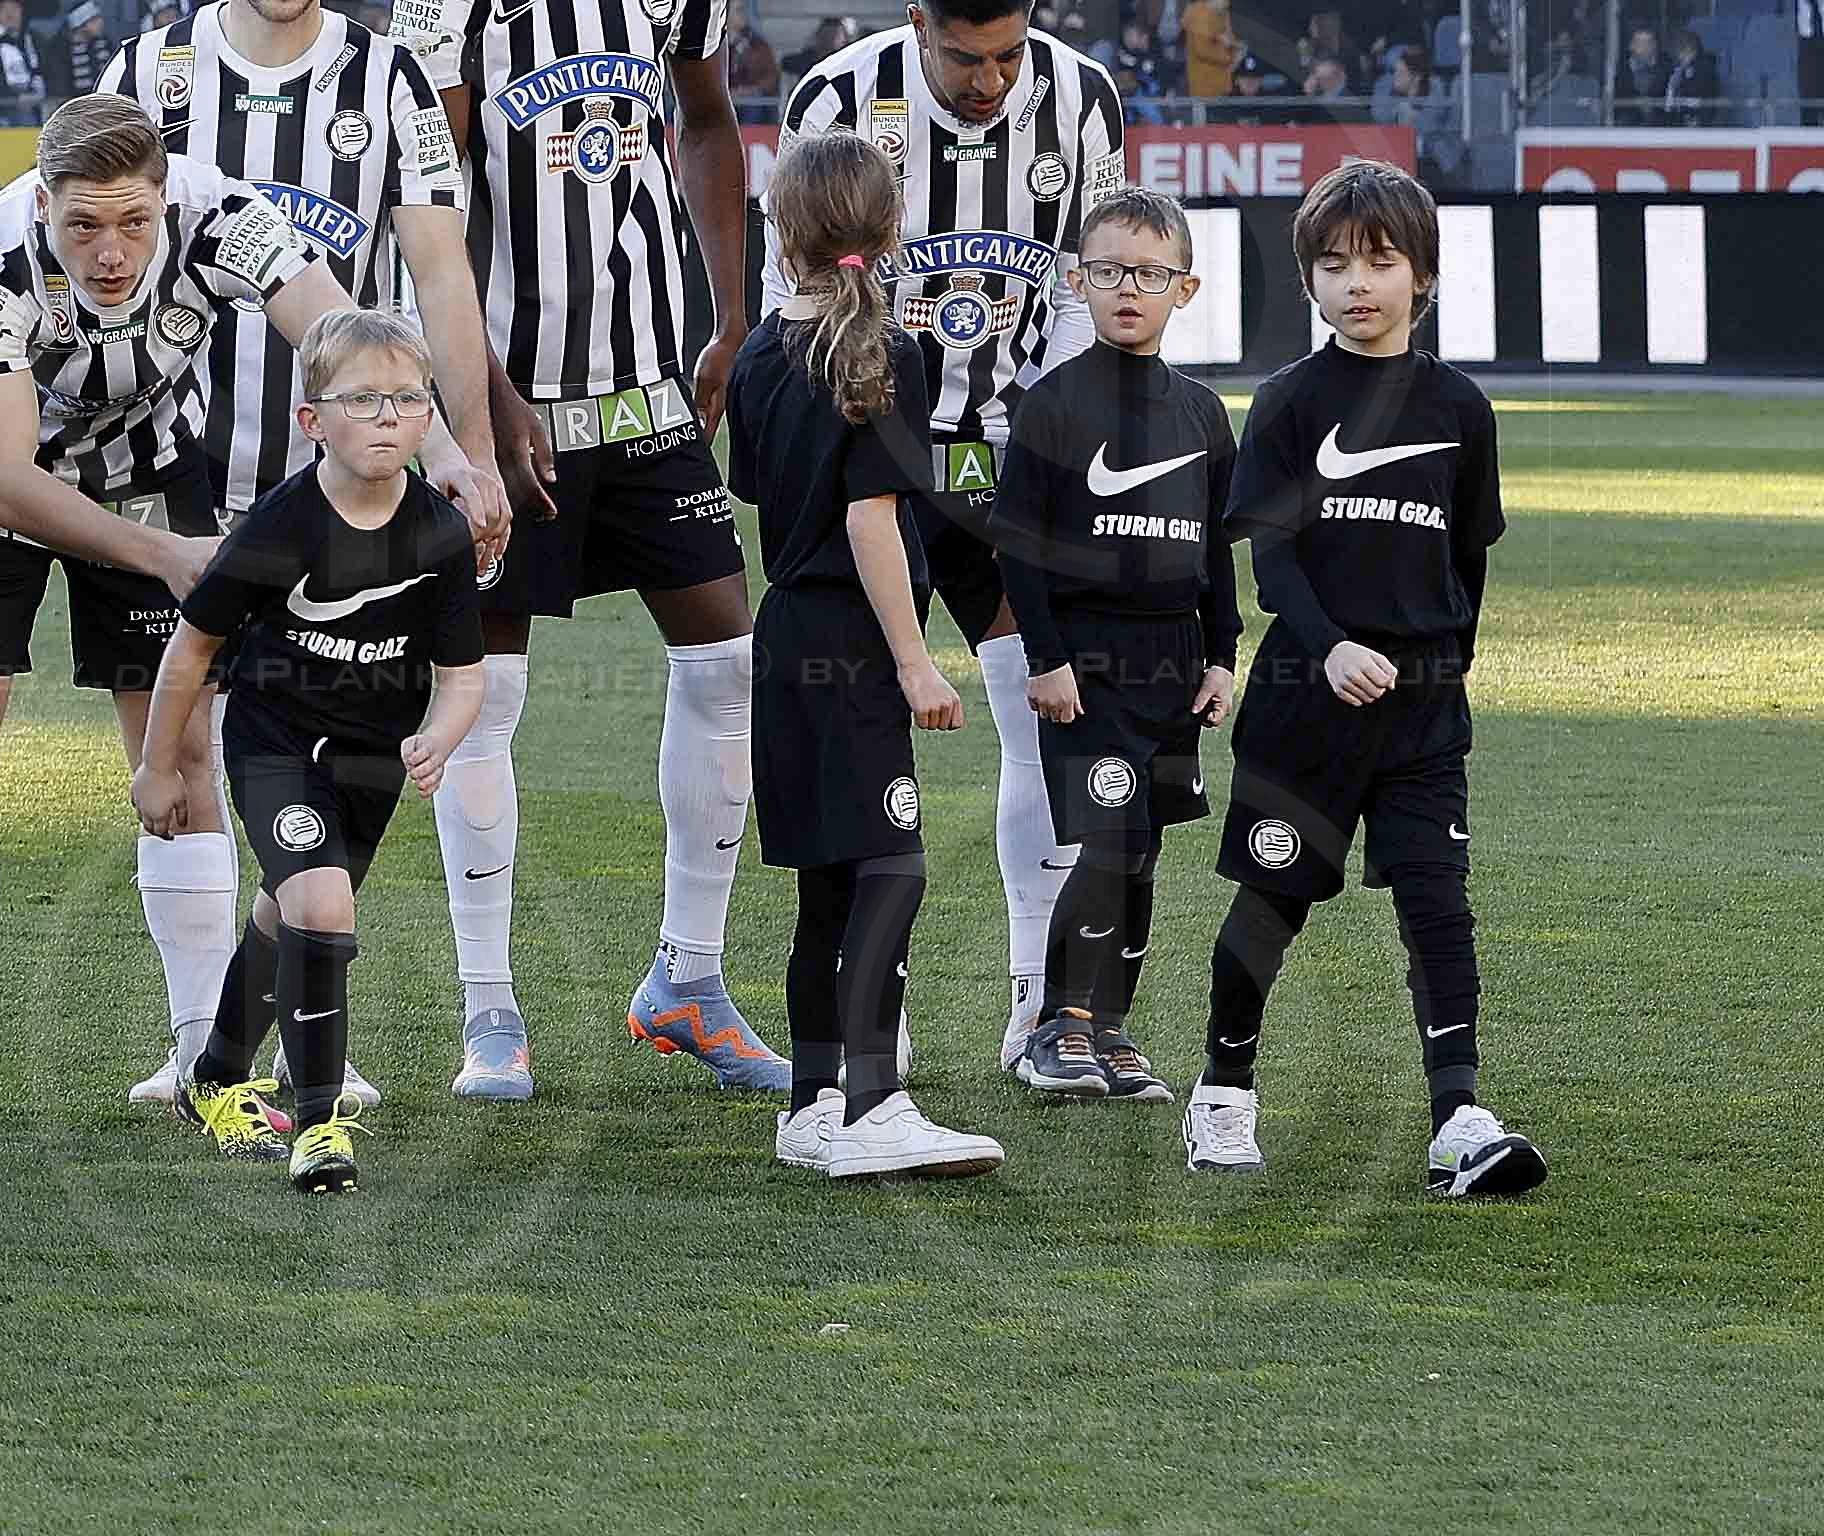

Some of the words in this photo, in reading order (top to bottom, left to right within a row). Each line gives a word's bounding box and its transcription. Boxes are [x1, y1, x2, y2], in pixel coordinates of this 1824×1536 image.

[249, 99, 294, 113] GRAWE
[873, 116, 906, 124] BUNDES
[958, 146, 997, 161] GRAWE
[1138, 143, 1305, 196] EINE
[103, 324, 145, 343] GRAWE
[566, 386, 683, 445] RAZ
[625, 424, 697, 459] HOLDING
[674, 485, 728, 508] DOMA
[694, 499, 732, 519] KILG
[1321, 497, 1395, 524] STURM
[1399, 501, 1447, 530] GRA
[1092, 514, 1166, 538] STURM
[129, 608, 182, 621] DOMA
[285, 629, 356, 663] STURM
